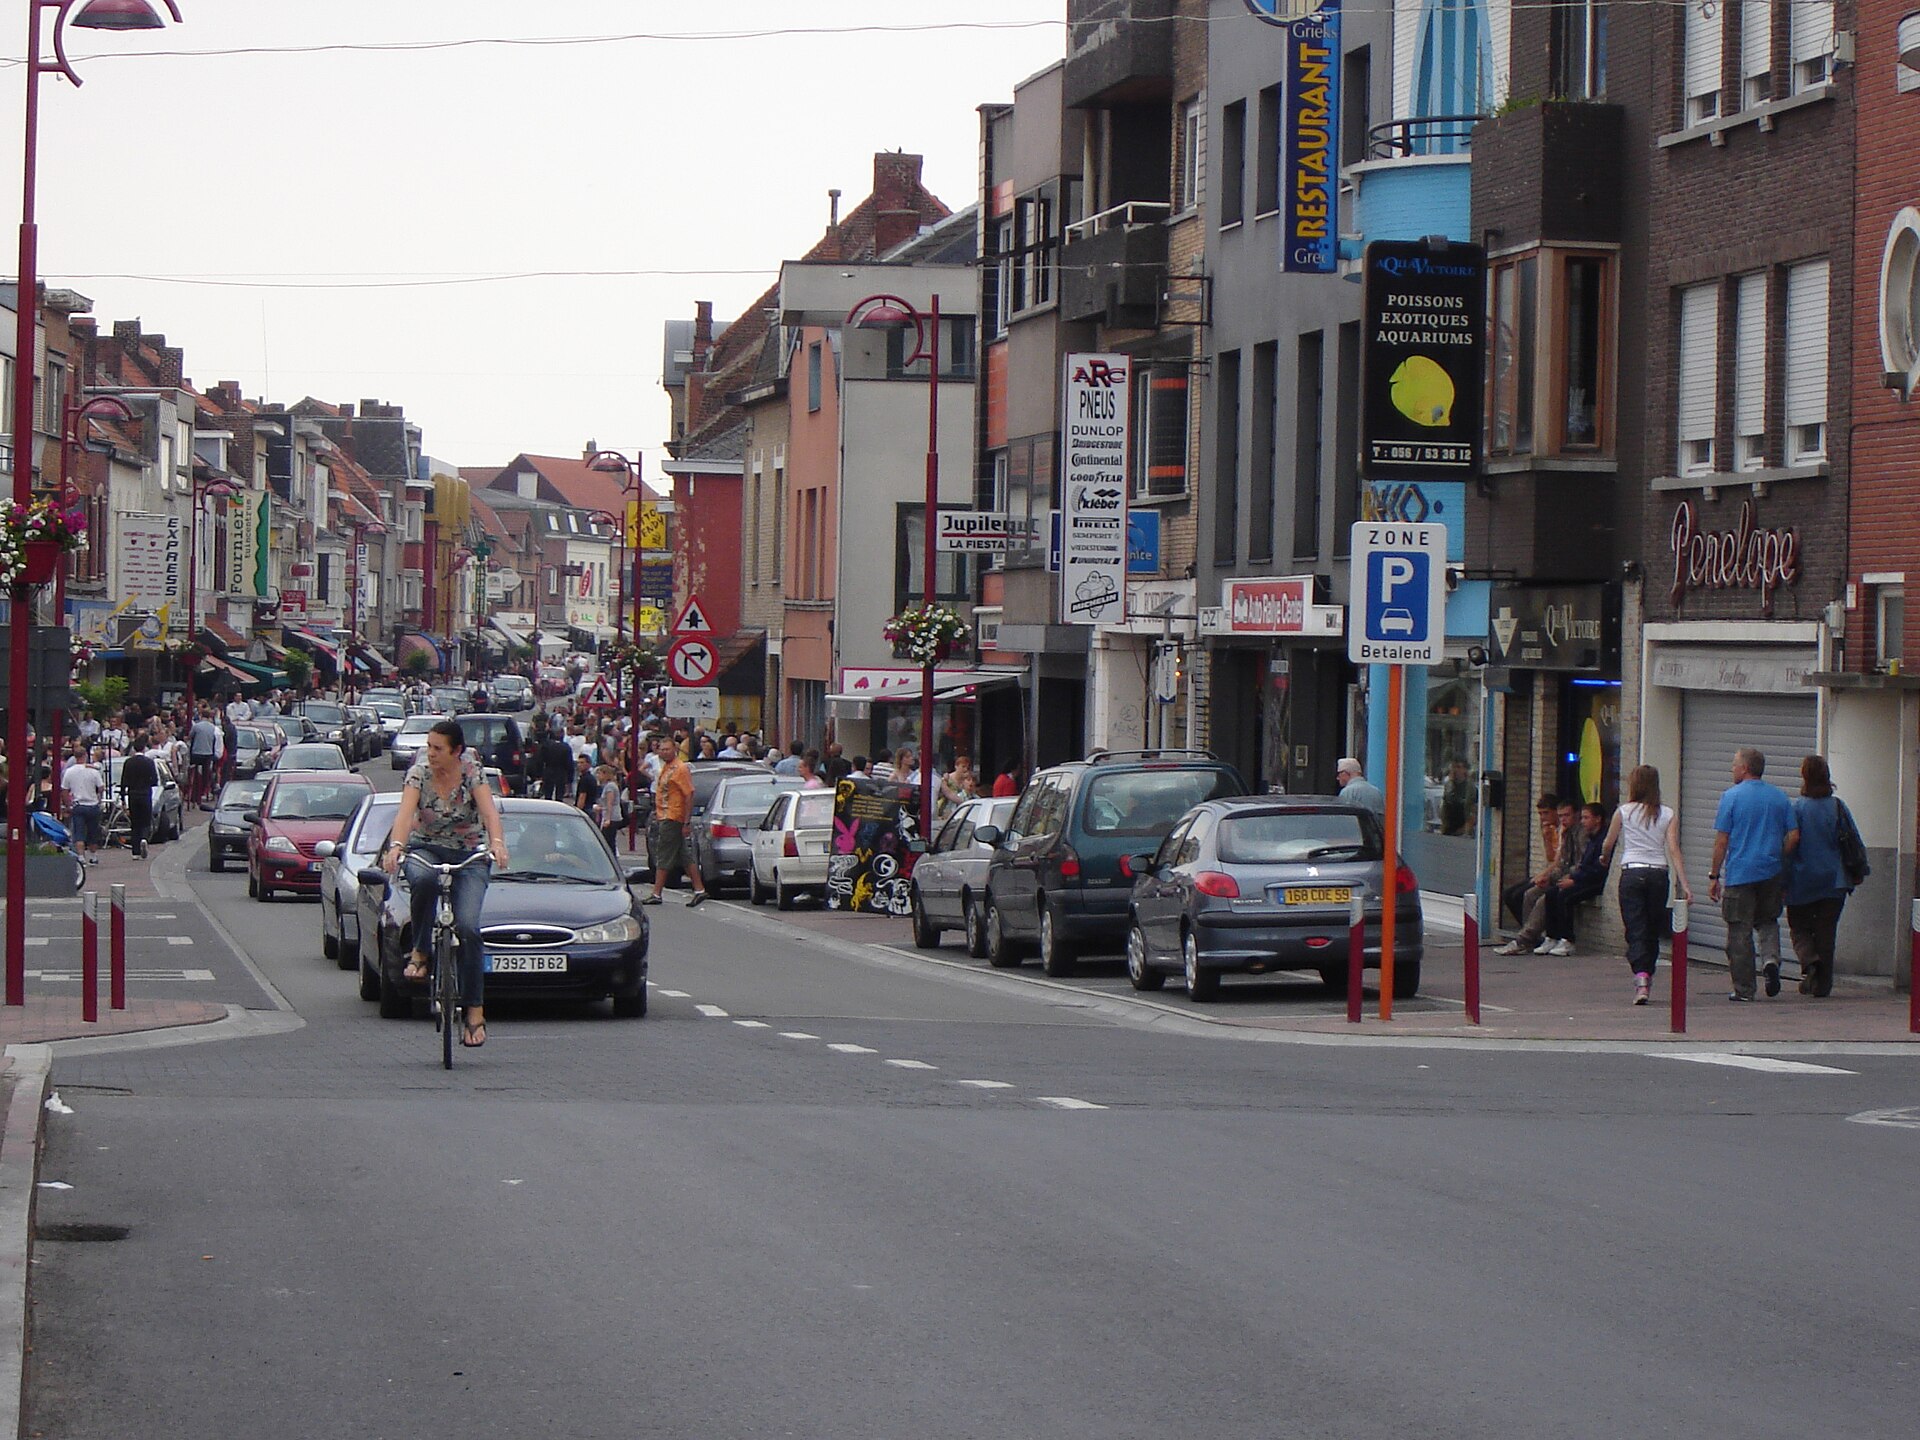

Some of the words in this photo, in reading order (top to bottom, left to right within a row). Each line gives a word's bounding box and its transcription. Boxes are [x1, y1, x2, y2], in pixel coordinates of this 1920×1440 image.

[1293, 22, 1338, 38] Grieks
[1296, 42, 1330, 238] RESTAURANT
[1294, 247, 1329, 264] Grec
[1387, 294, 1463, 308] POISSONS
[1381, 312, 1469, 327] EXOTIQUES
[1376, 330, 1473, 345] AQUARIUMS
[1072, 359, 1126, 388] ARC
[1079, 390, 1116, 420] PNEUS
[1071, 425, 1124, 436] DUNLOP
[1071, 453, 1123, 467] Continental
[1072, 517, 1120, 529] PIRELLI
[949, 540, 963, 549] LA
[966, 540, 1006, 549] FIESTA
[1368, 530, 1430, 546] ZONE
[165, 517, 179, 597] EXPRESS
[230, 508, 244, 595] Fournier
[1670, 500, 1797, 609] Penelope
[1381, 556, 1414, 603] P
[1360, 645, 1432, 660] Betalend
[1286, 890, 1308, 902] 168
[1335, 889, 1349, 900] 59
[494, 957, 526, 970] 7392
[529, 957, 545, 969] TB
[547, 957, 564, 969] 62
